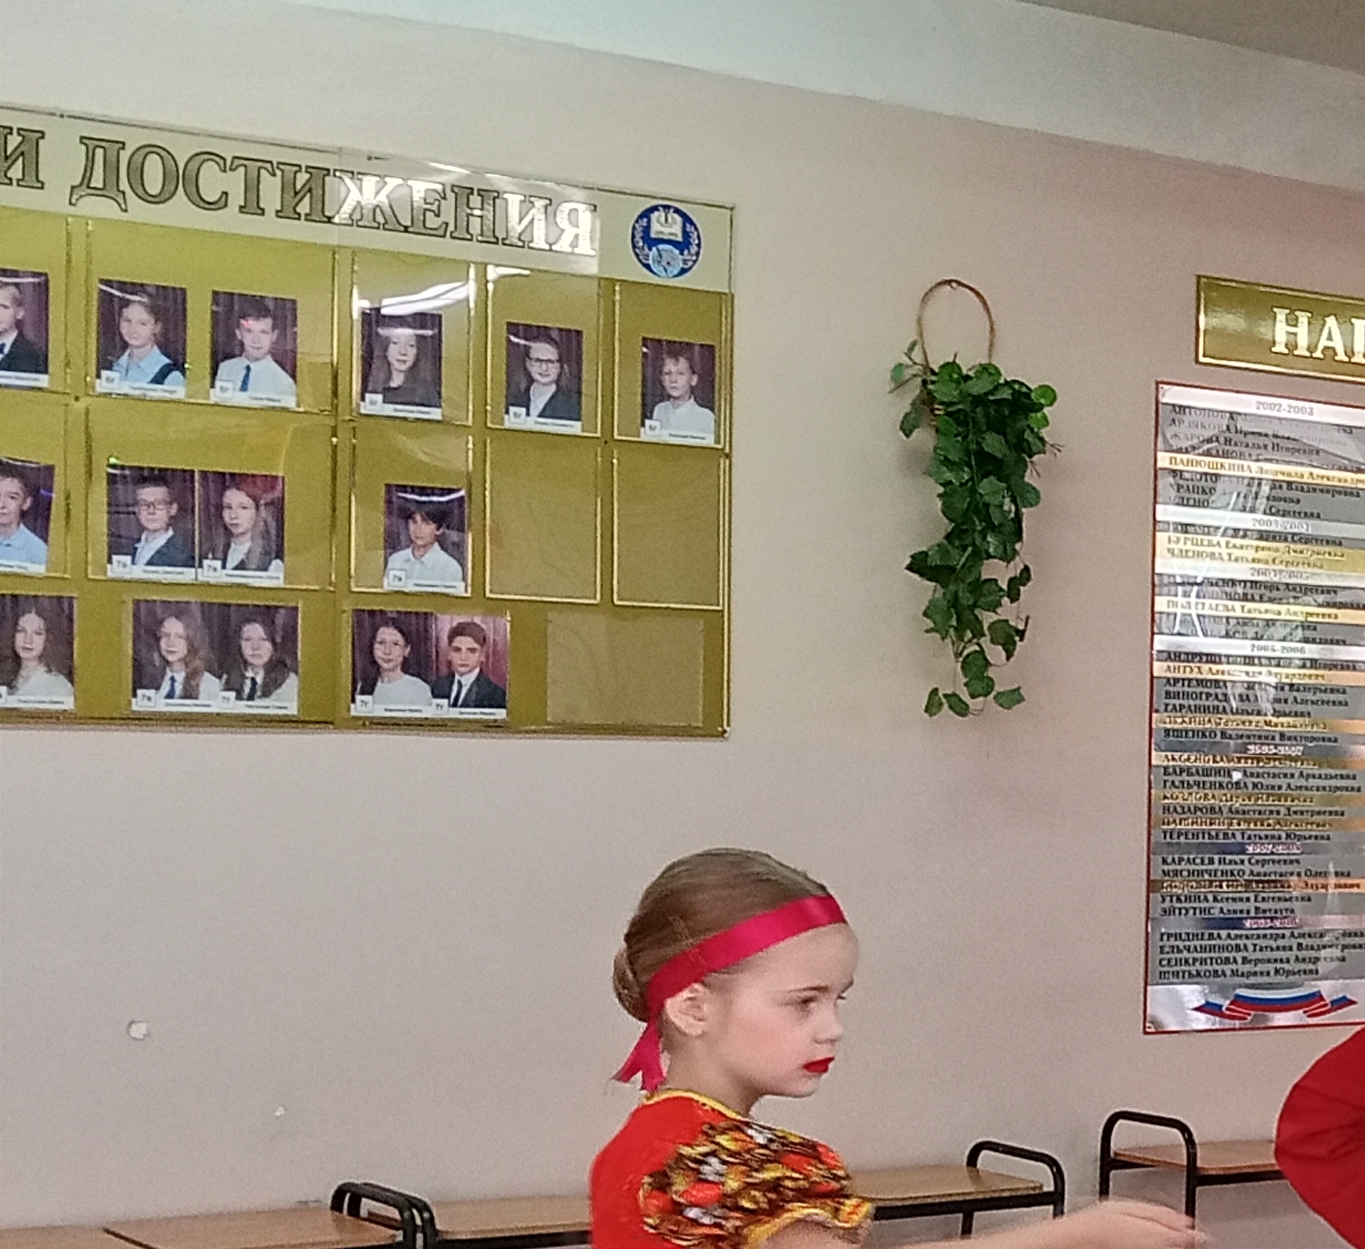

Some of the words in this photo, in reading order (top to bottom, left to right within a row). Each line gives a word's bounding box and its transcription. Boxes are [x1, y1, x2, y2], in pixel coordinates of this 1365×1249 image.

[69, 134, 597, 259] ДОСТИЖЕНИЯ
[1169, 456, 1253, 475] ПАНЮШКИНА
[1220, 731, 1276, 743] Валентина
[1278, 733, 1339, 744] Викторовна
[1162, 767, 1242, 780] БАРБАШИН
[1243, 769, 1296, 780] Анастасия
[1162, 779, 1249, 791] ГАЛЬЧЕНКОВА
[1286, 783, 1361, 794] Александровна
[1161, 805, 1224, 817] НАЗАРОВА
[1227, 806, 1281, 817] Анастасия
[1161, 829, 1237, 841] ТЕРЕНТЬЕВА
[1240, 831, 1283, 842] Татьяна
[1285, 832, 1332, 843] Юрьевна
[1161, 855, 1215, 867] КАРАСЕВ
[1248, 857, 1301, 870] Сергеевич
[1160, 930, 1223, 943] ГРИДНЕВА
[1225, 930, 1286, 942] Александра
